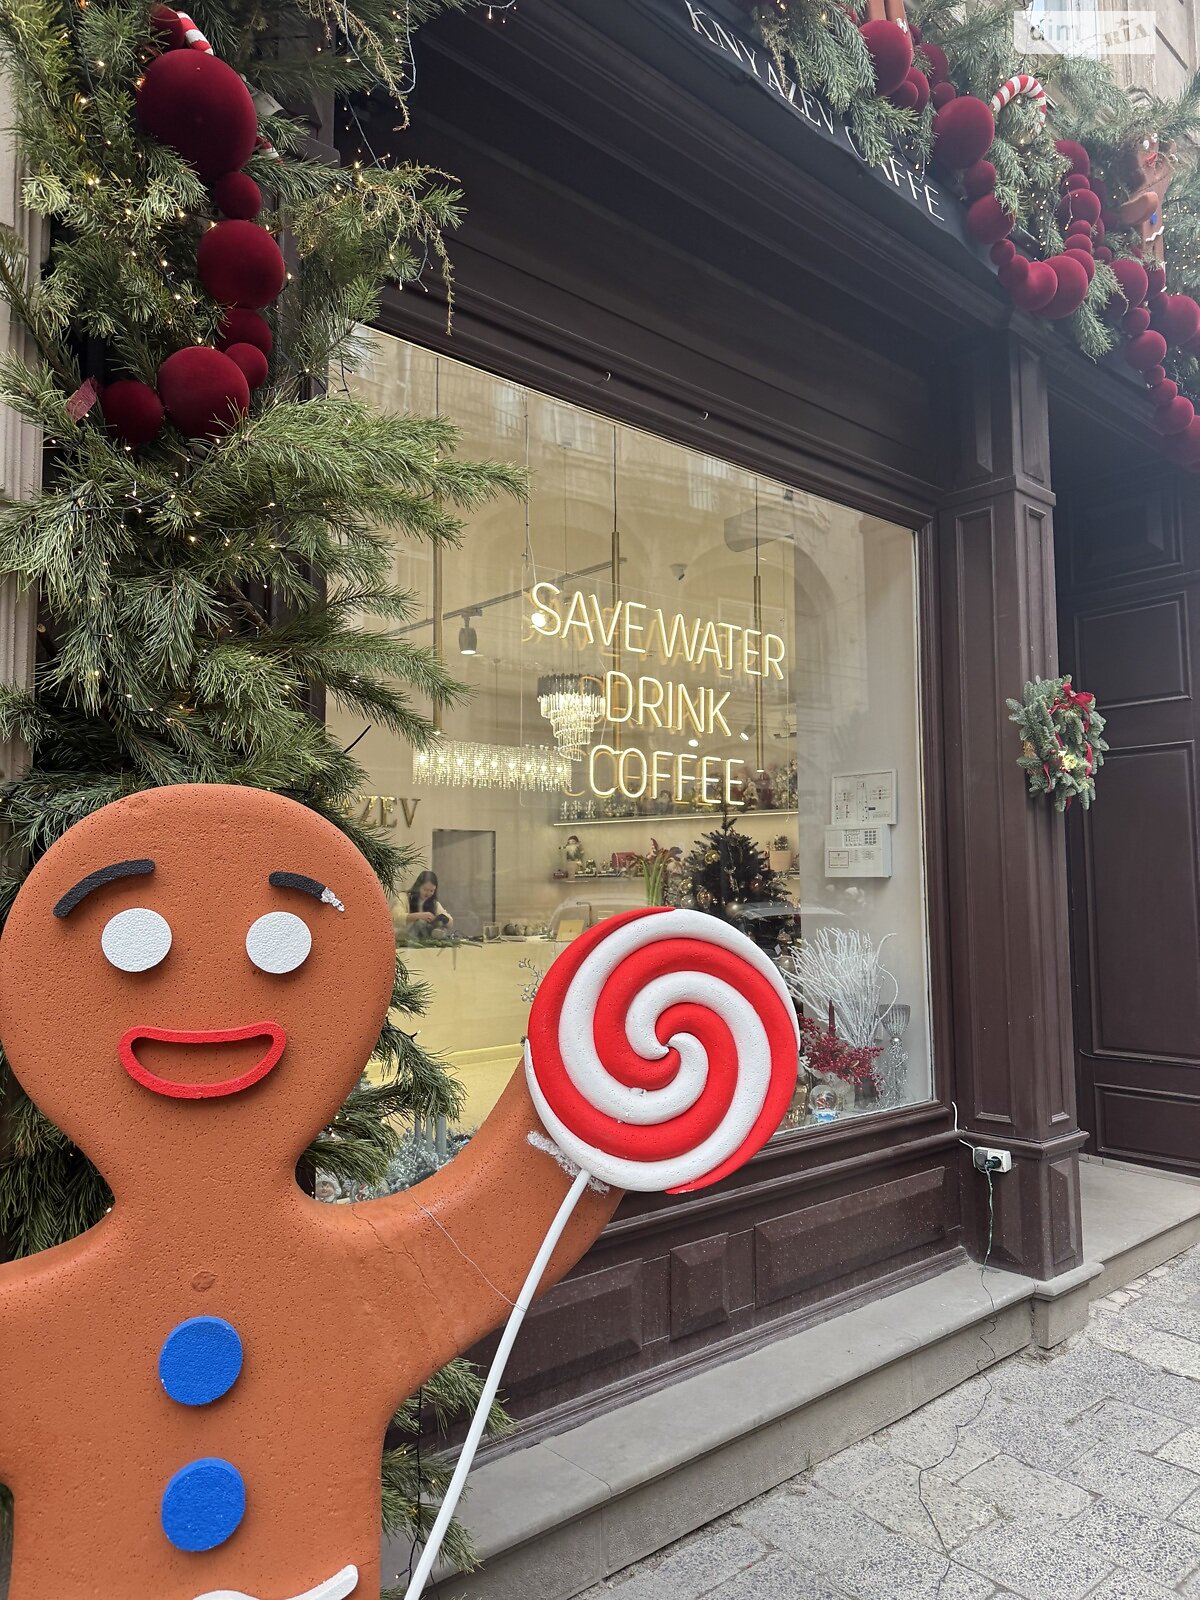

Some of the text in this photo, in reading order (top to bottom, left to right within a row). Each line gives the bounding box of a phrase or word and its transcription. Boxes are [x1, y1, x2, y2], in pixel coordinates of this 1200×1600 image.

[685, 0, 834, 135] KNYAZEV
[531, 582, 785, 680] SAVE WATER
[606, 671, 731, 736] DRINK
[589, 744, 744, 805] COFFEE
